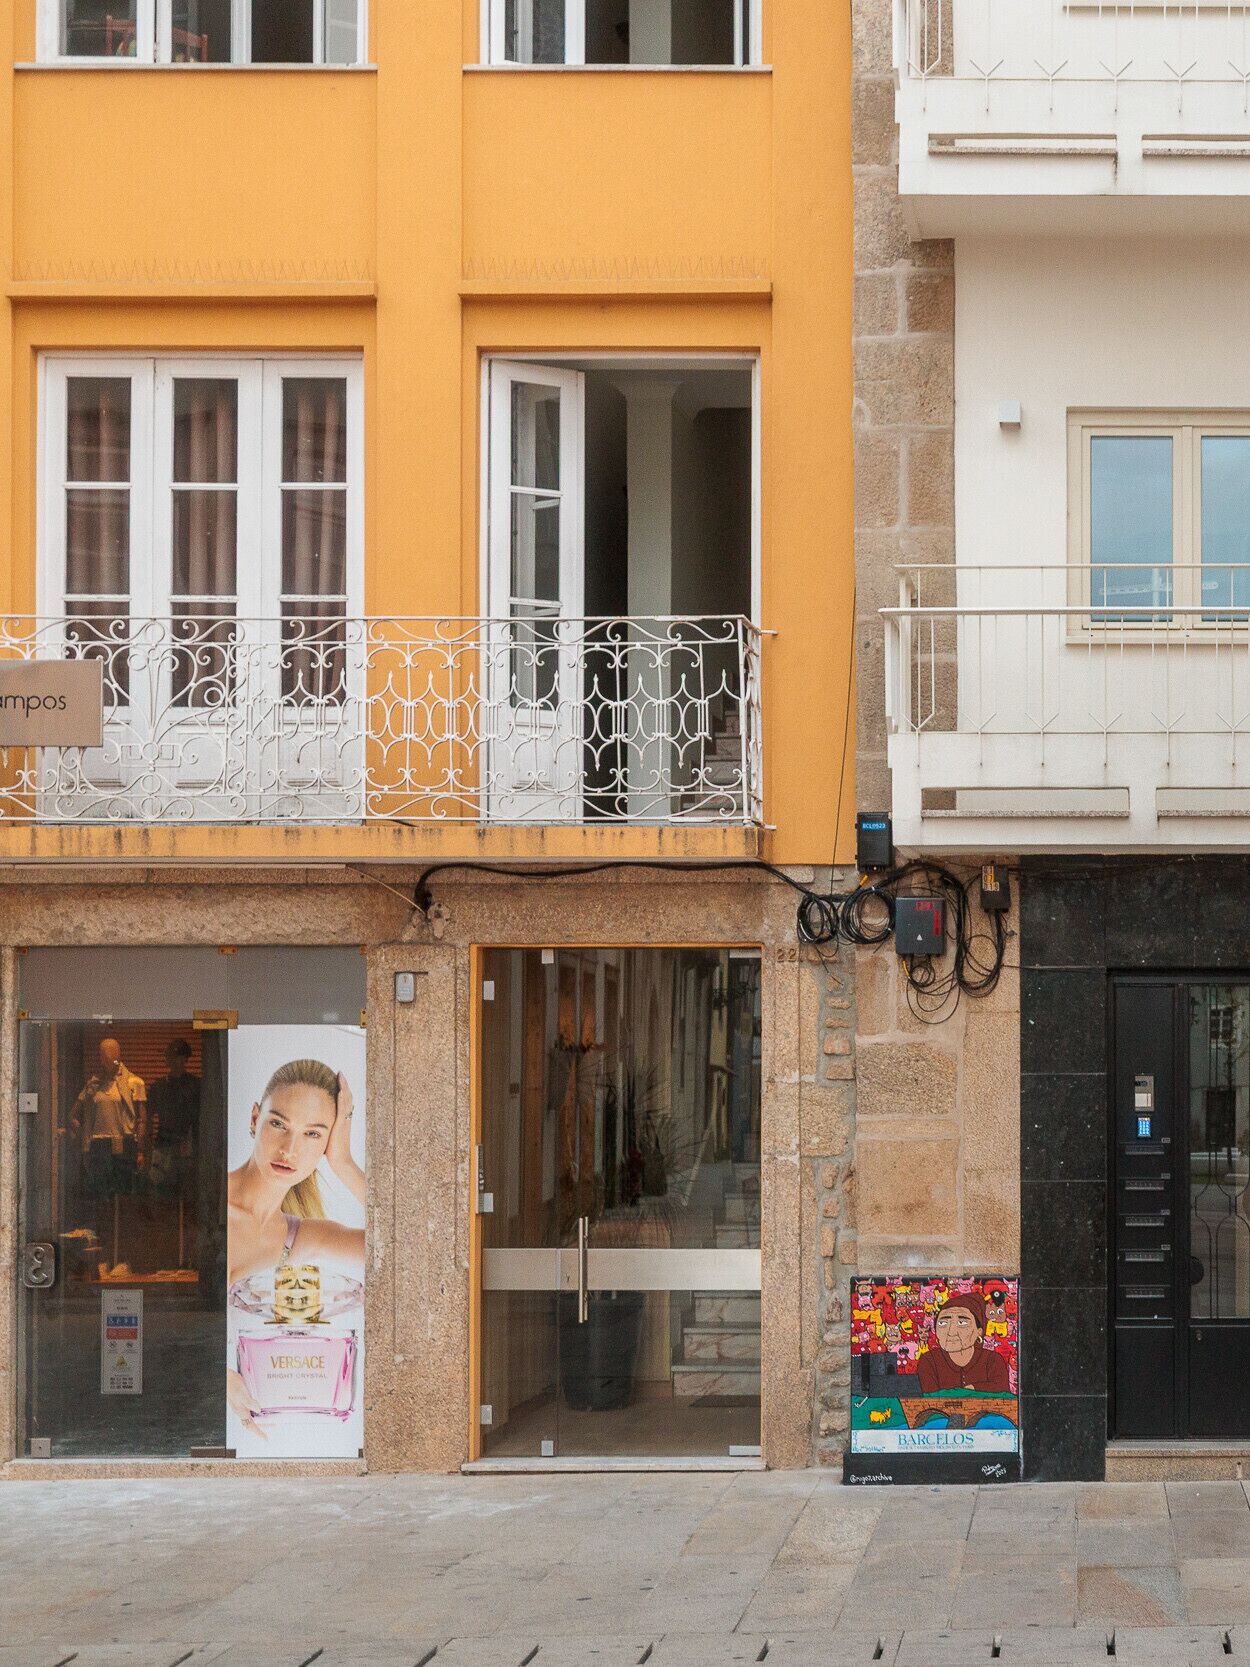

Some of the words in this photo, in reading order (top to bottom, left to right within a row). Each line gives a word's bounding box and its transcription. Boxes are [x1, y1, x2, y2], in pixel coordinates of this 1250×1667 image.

[0, 695, 67, 718] mpos
[776, 948, 797, 963] 22
[270, 1356, 325, 1369] VERSACE
[897, 1432, 975, 1445] BARCELOS
